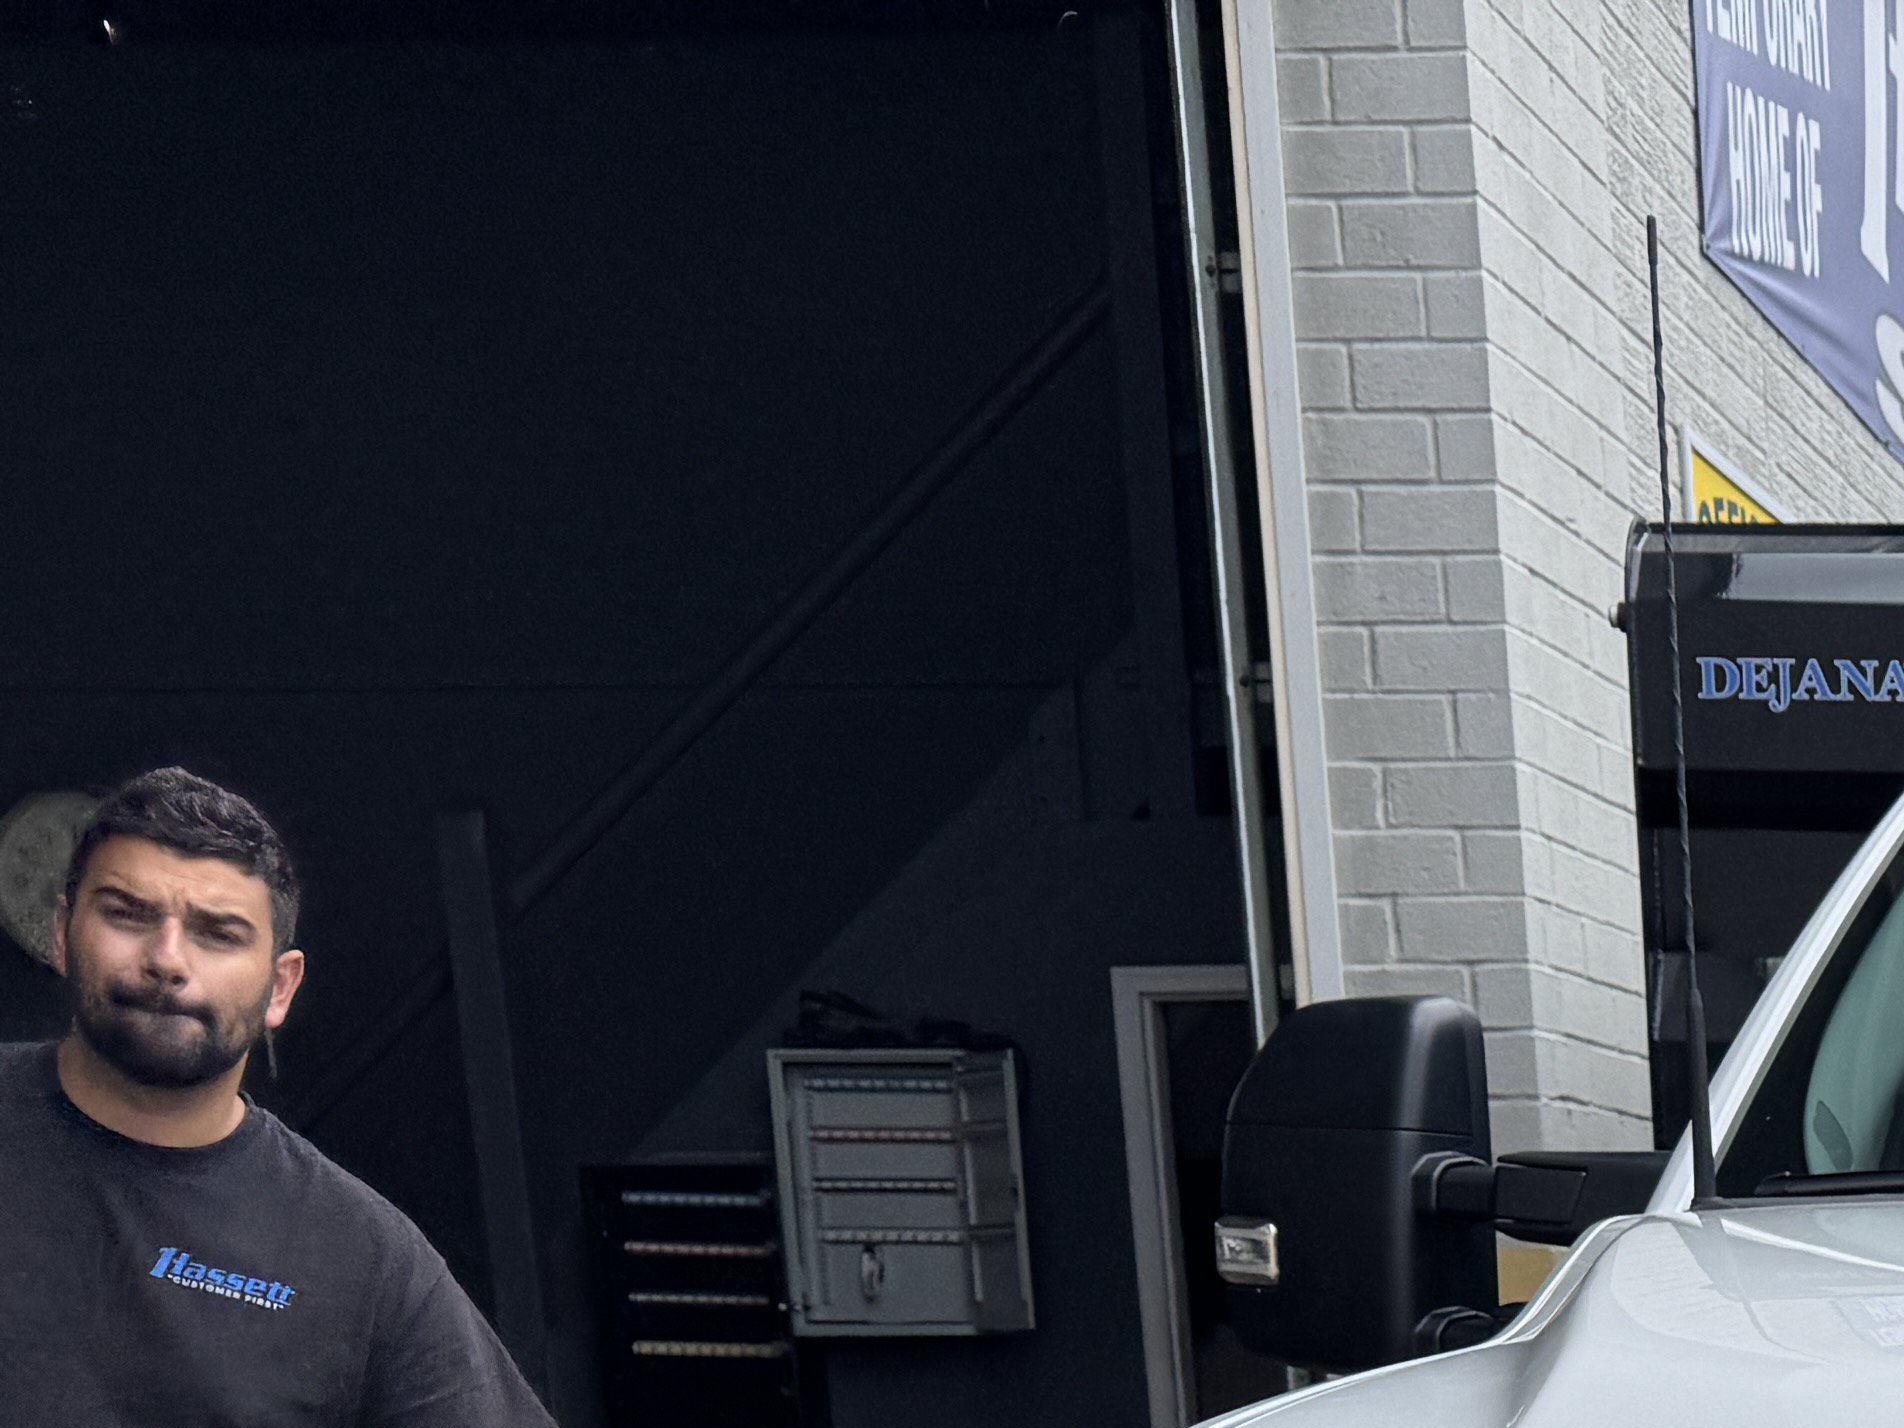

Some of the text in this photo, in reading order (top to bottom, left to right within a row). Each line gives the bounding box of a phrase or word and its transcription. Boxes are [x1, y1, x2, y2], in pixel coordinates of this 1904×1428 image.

[1727, 81, 1822, 279] HOME OF
[149, 1246, 298, 1307] Hassett
